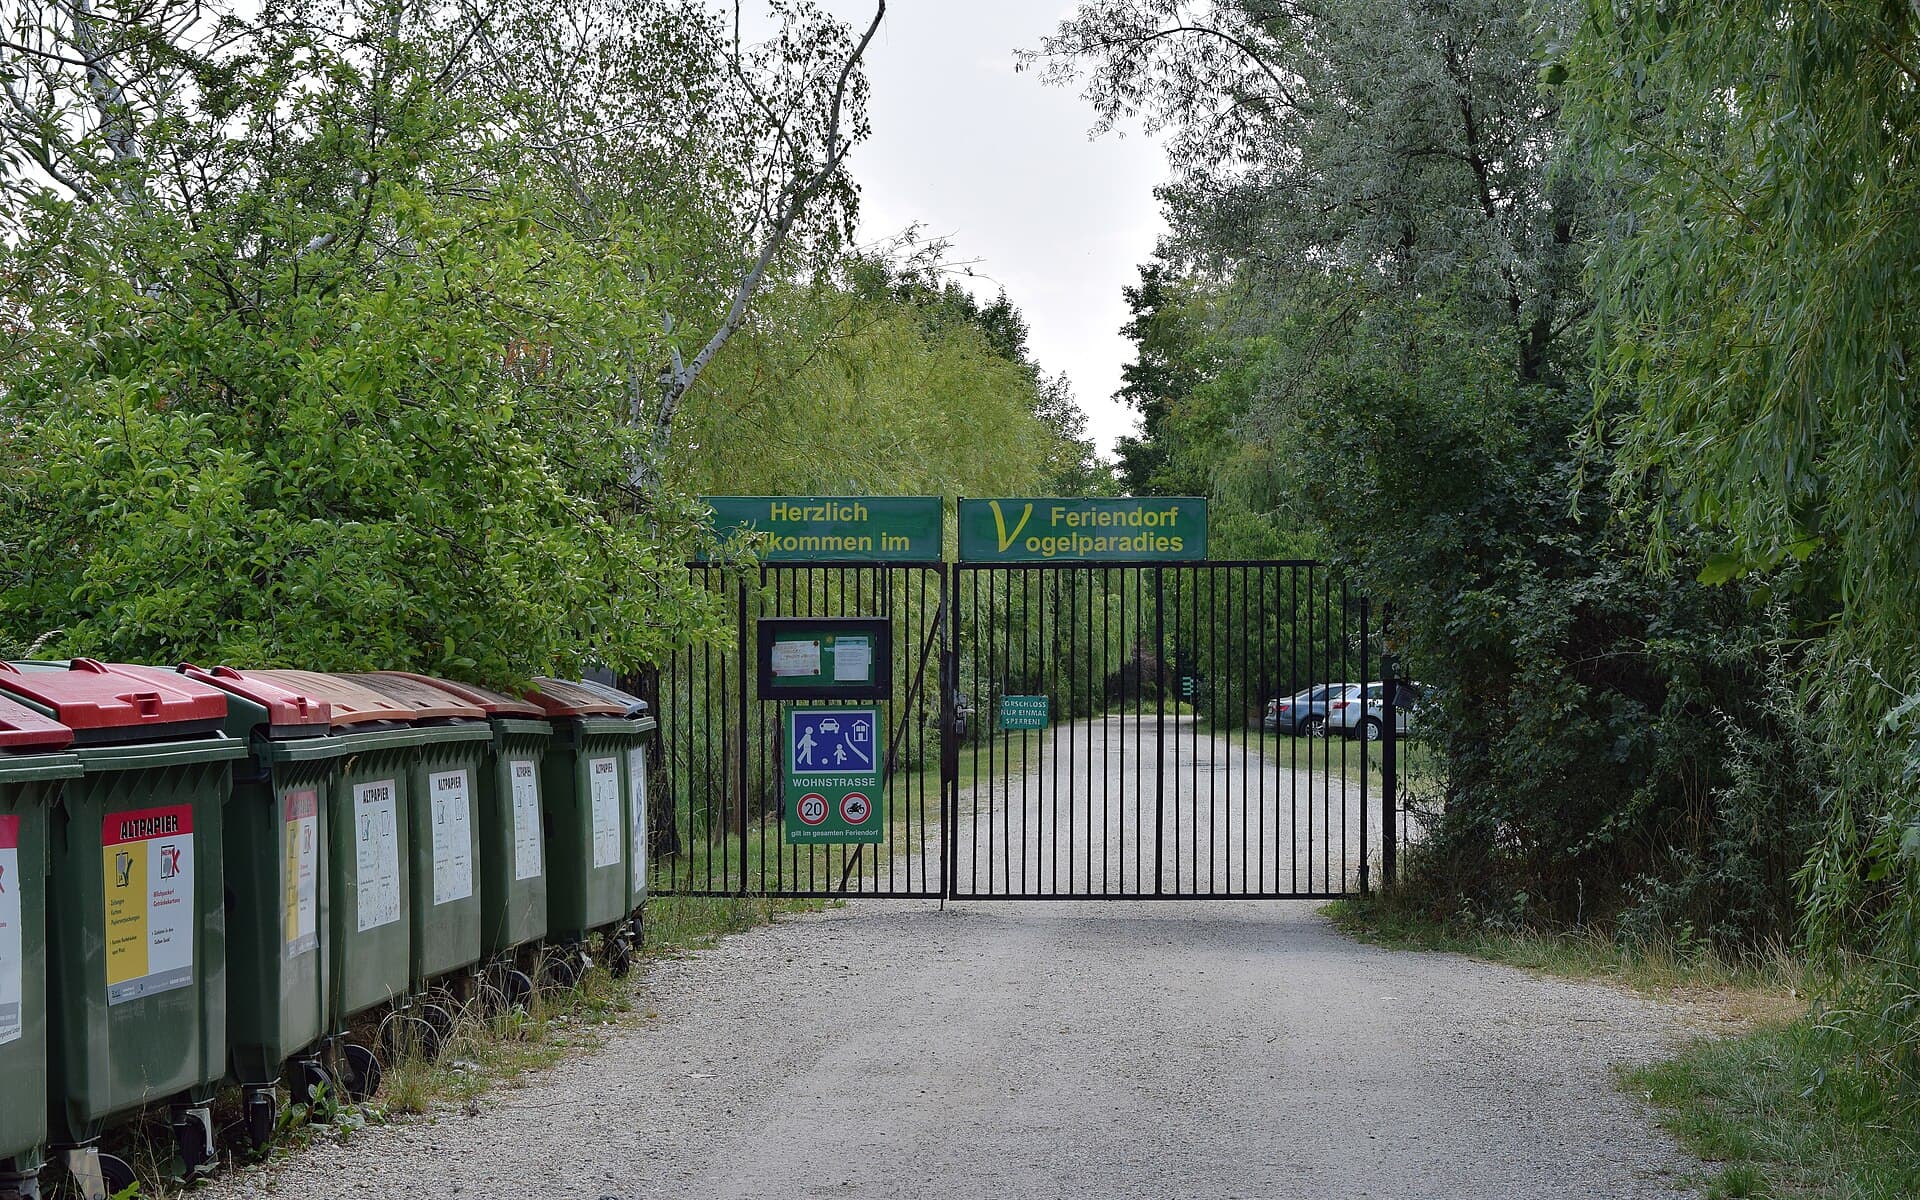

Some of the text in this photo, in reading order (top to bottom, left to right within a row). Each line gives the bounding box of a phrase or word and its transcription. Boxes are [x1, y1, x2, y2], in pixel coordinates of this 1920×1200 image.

[771, 502, 868, 521] Herzlich
[1051, 507, 1179, 527] Feriendorf
[988, 500, 1184, 557] Vogelparadies
[742, 532, 910, 551] kommen im
[1018, 709, 1047, 717] EINMAL
[438, 776, 462, 791] ALTPAPIER
[792, 777, 876, 787] WOHNSTRASSE
[362, 786, 389, 804] ALTPAPIER
[805, 802, 822, 816] 20
[120, 815, 178, 840] ALTPAPIER
[812, 829, 844, 837] gesamten
[845, 829, 879, 837] Feriendorf
